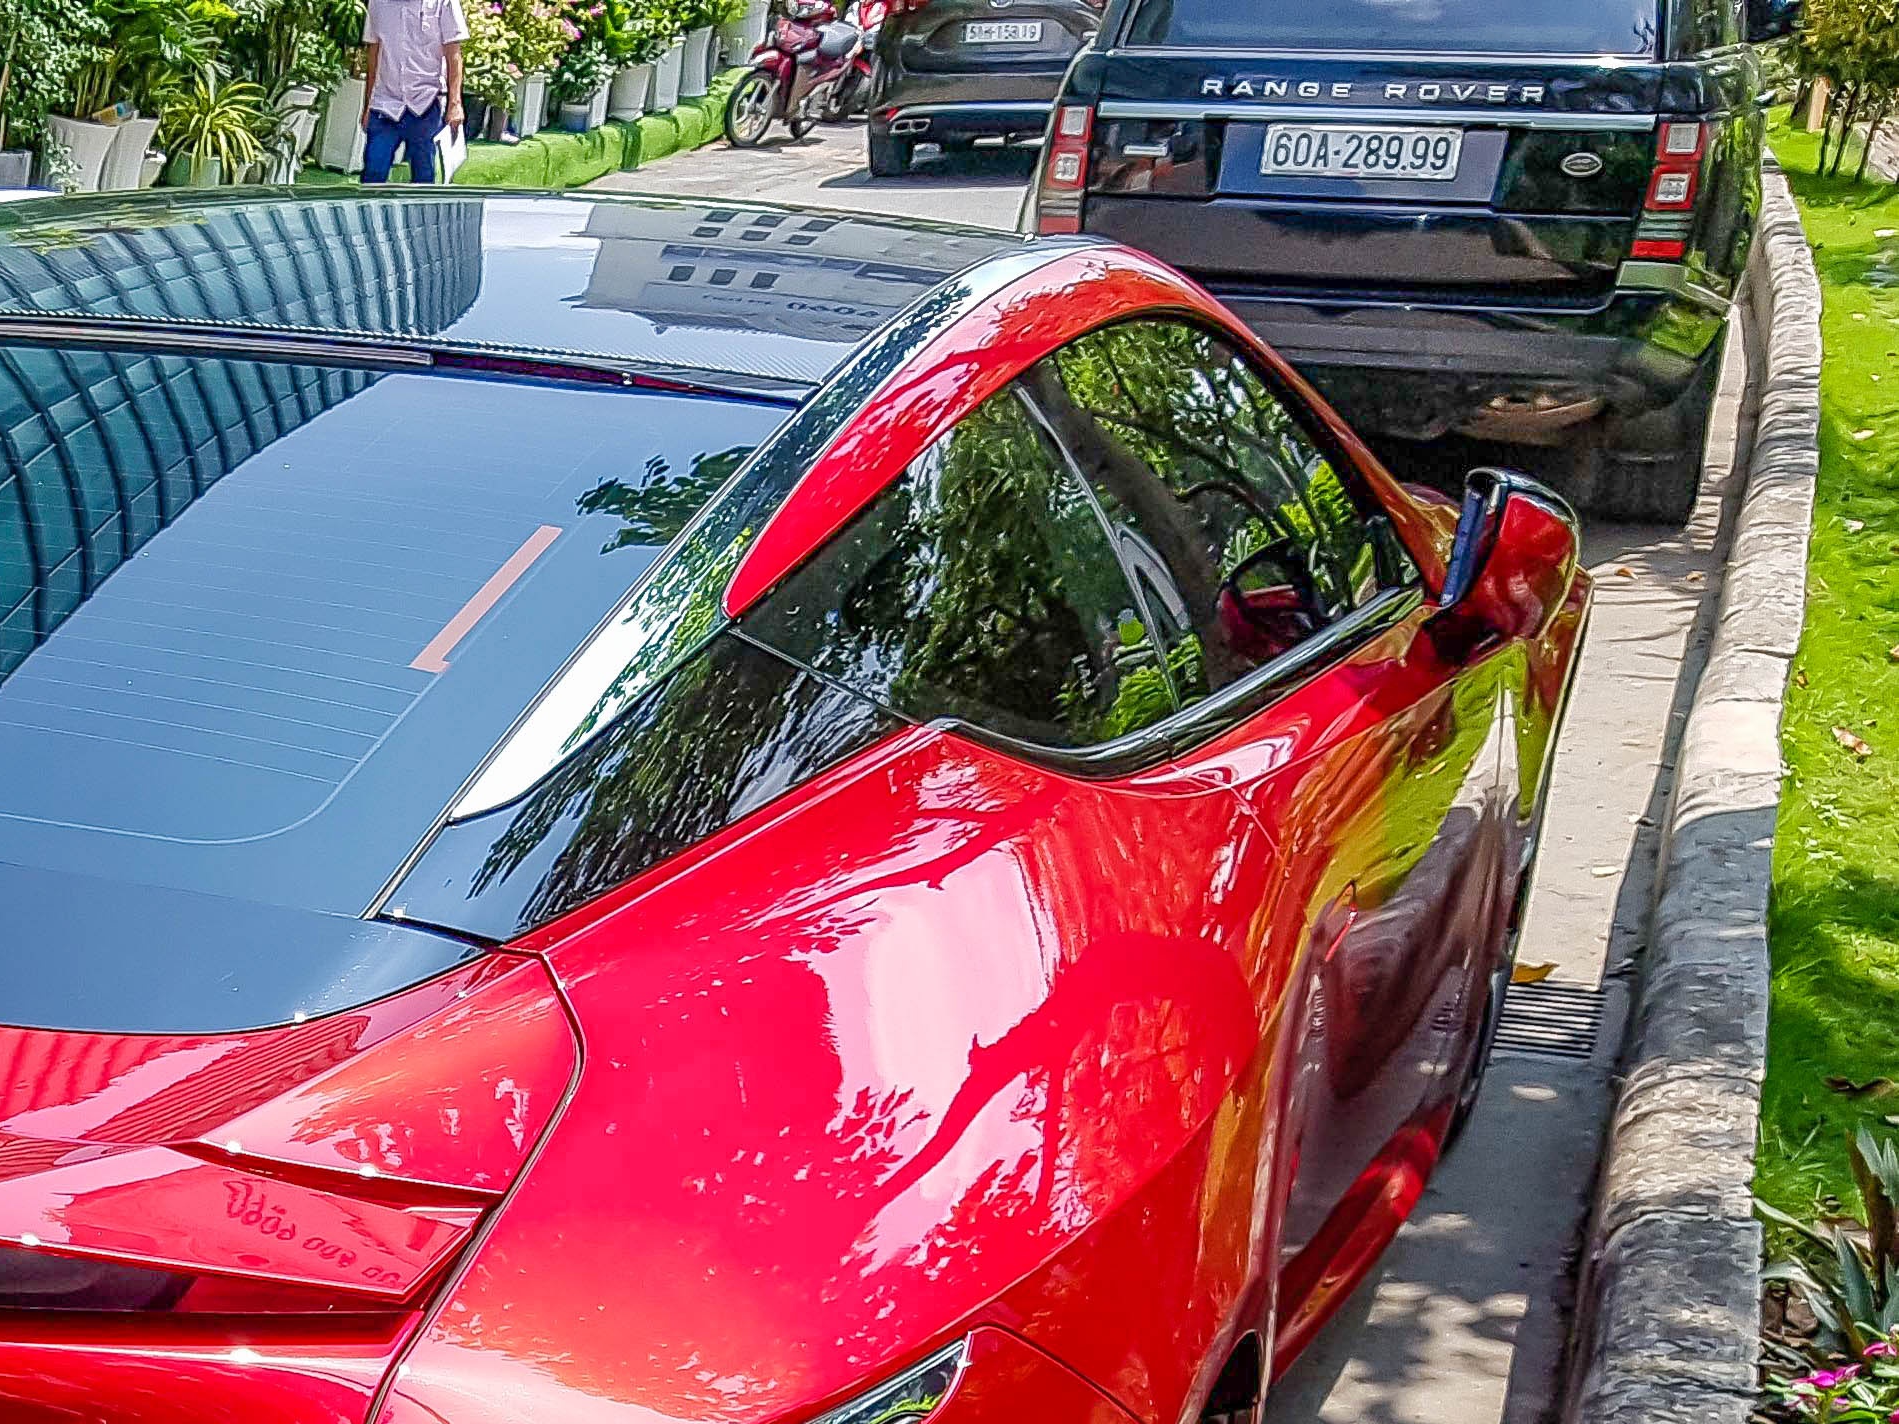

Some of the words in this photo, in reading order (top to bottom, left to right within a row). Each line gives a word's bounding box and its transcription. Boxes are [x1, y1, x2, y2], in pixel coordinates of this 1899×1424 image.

[1201, 79, 1352, 98] RANGE
[1383, 82, 1545, 102] ROVER
[1271, 131, 1452, 171] 60A-289.99
